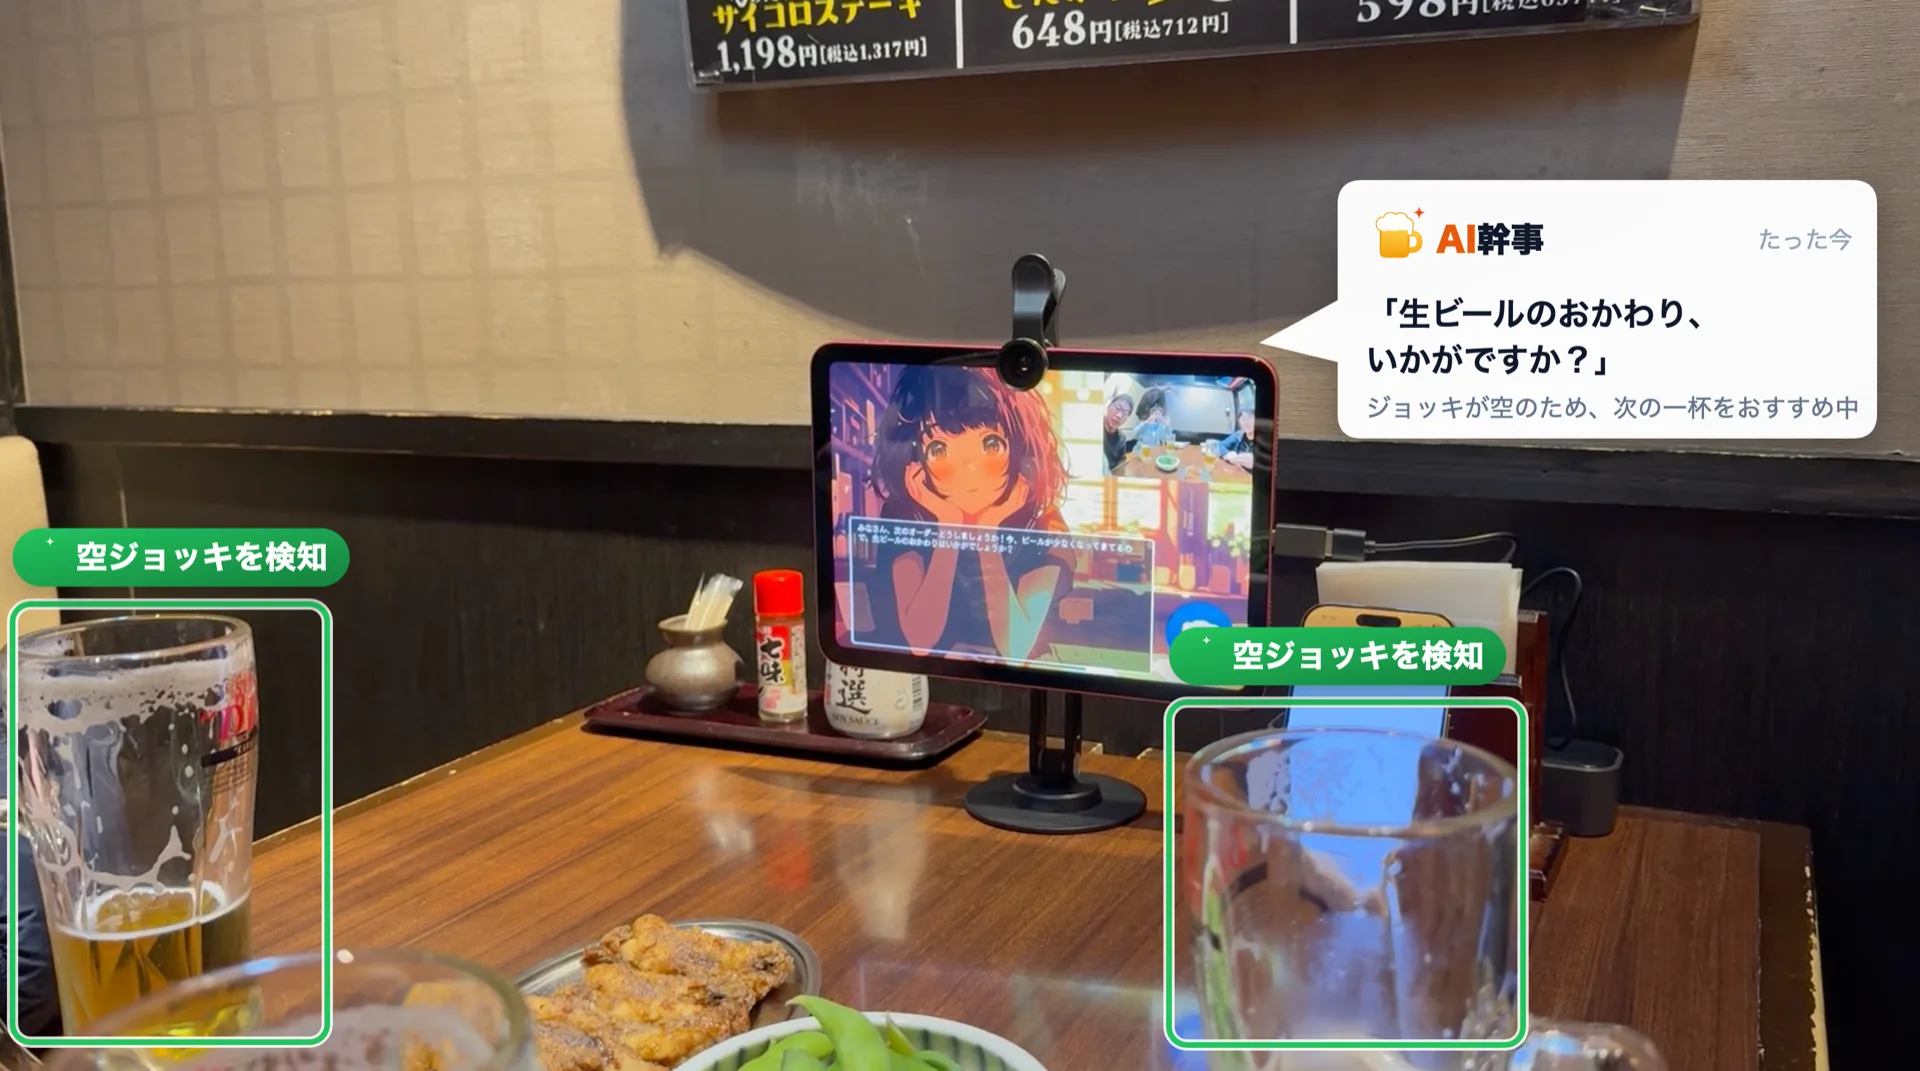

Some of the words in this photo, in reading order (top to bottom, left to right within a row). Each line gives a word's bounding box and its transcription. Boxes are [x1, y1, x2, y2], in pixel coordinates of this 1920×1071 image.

[712, 0, 922, 35] サイコロステーキ
[1011, 9, 1230, 50] 648円[税込712円]
[716, 34, 928, 75] 1,198円[税込1,317円]
